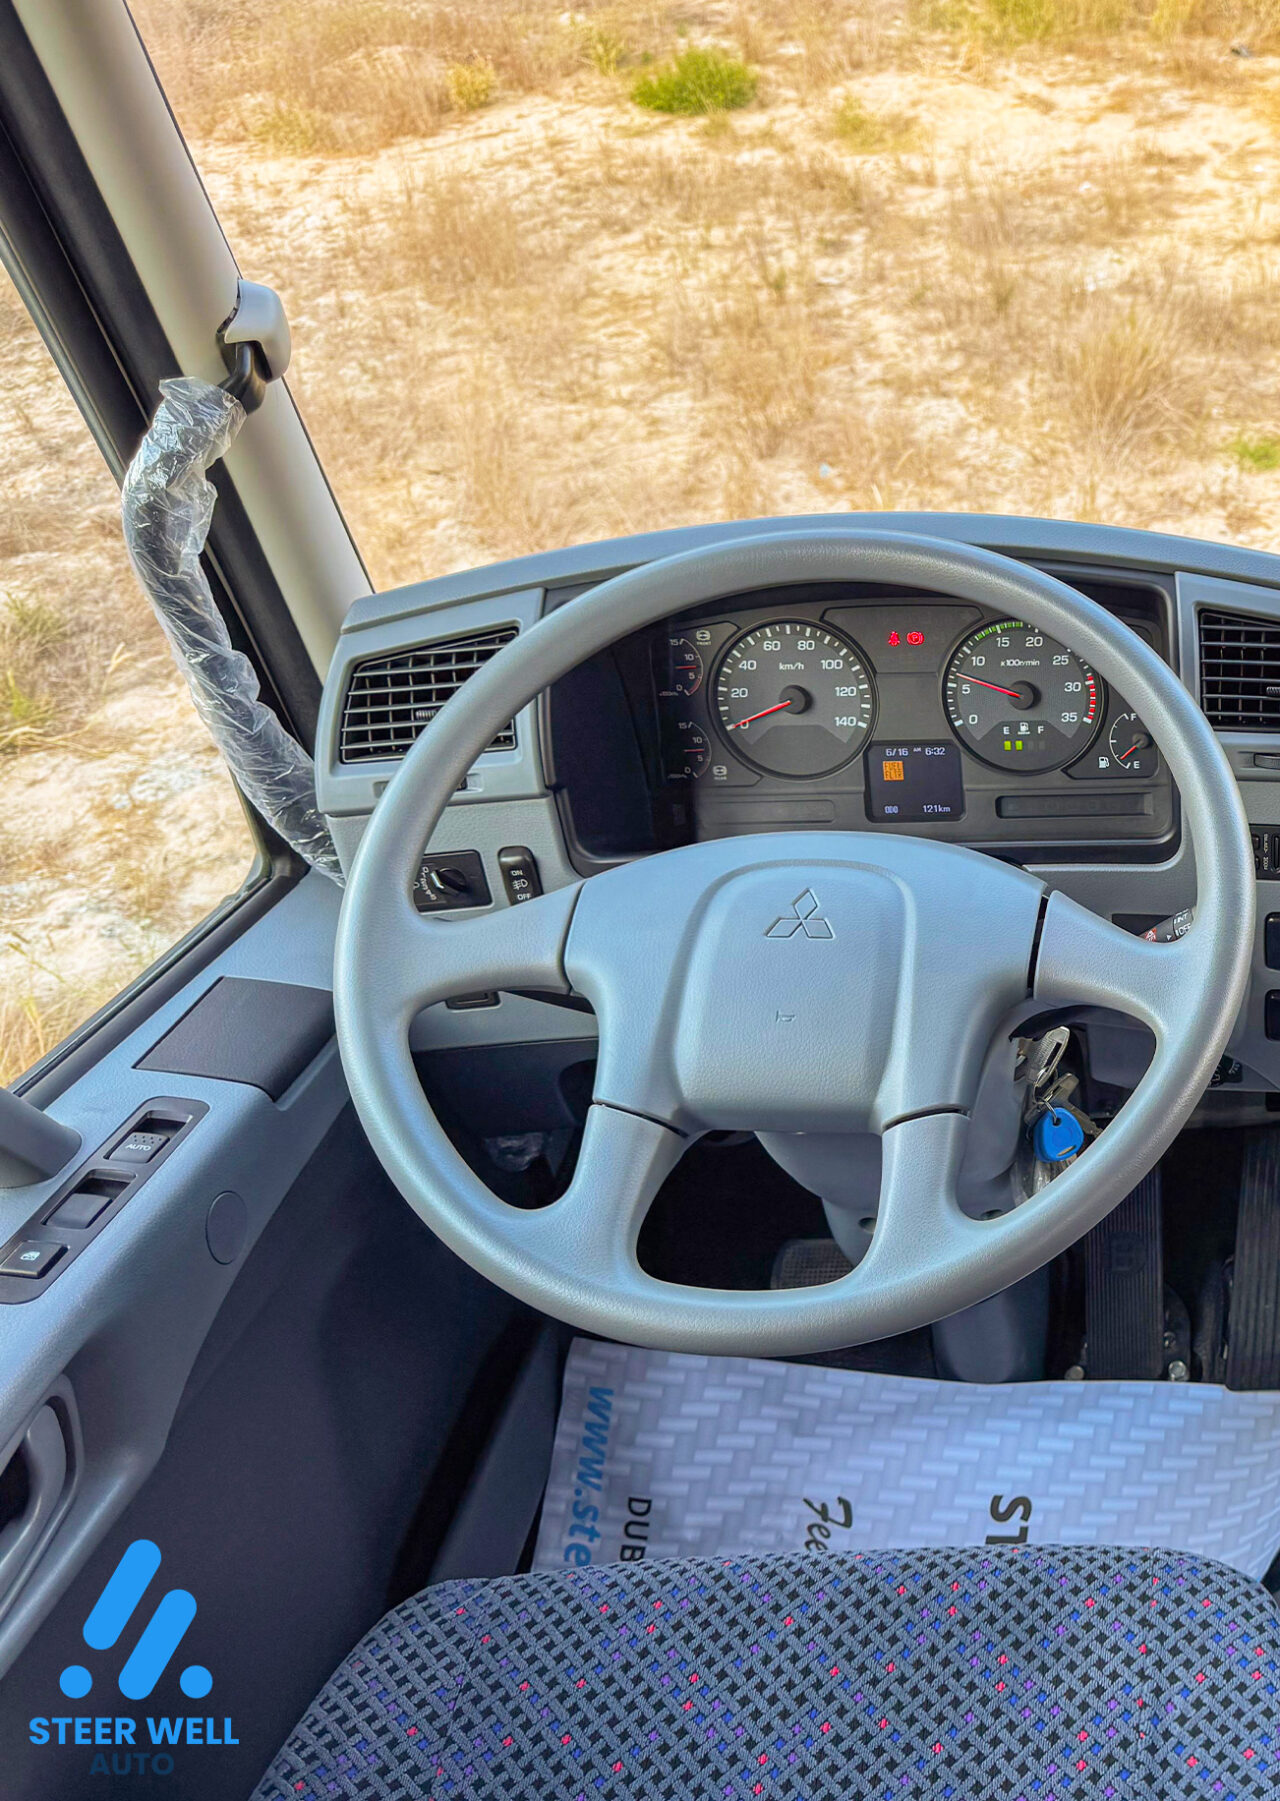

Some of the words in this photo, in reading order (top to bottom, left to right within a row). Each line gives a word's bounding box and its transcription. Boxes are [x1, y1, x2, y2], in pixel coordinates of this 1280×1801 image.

[764, 641, 781, 651] 60
[797, 640, 815, 650] 80
[997, 637, 1010, 647] 15
[1026, 637, 1043, 647] 20
[739, 660, 756, 670] 40
[820, 660, 843, 670] 100
[971, 656, 985, 666] 10
[1052, 656, 1069, 665] 25
[779, 662, 804, 671] km/h
[835, 687, 857, 697] 120
[962, 684, 971, 694] 5
[1064, 682, 1081, 692] 30
[731, 688, 748, 698] 20
[835, 717, 857, 727] 140
[969, 714, 978, 724] 0
[1061, 712, 1078, 722] 35
[1130, 713, 1137, 721] F
[1003, 726, 1010, 734] E
[1038, 725, 1044, 734] F
[925, 747, 946, 756] 6:32
[1133, 761, 1140, 769] E
